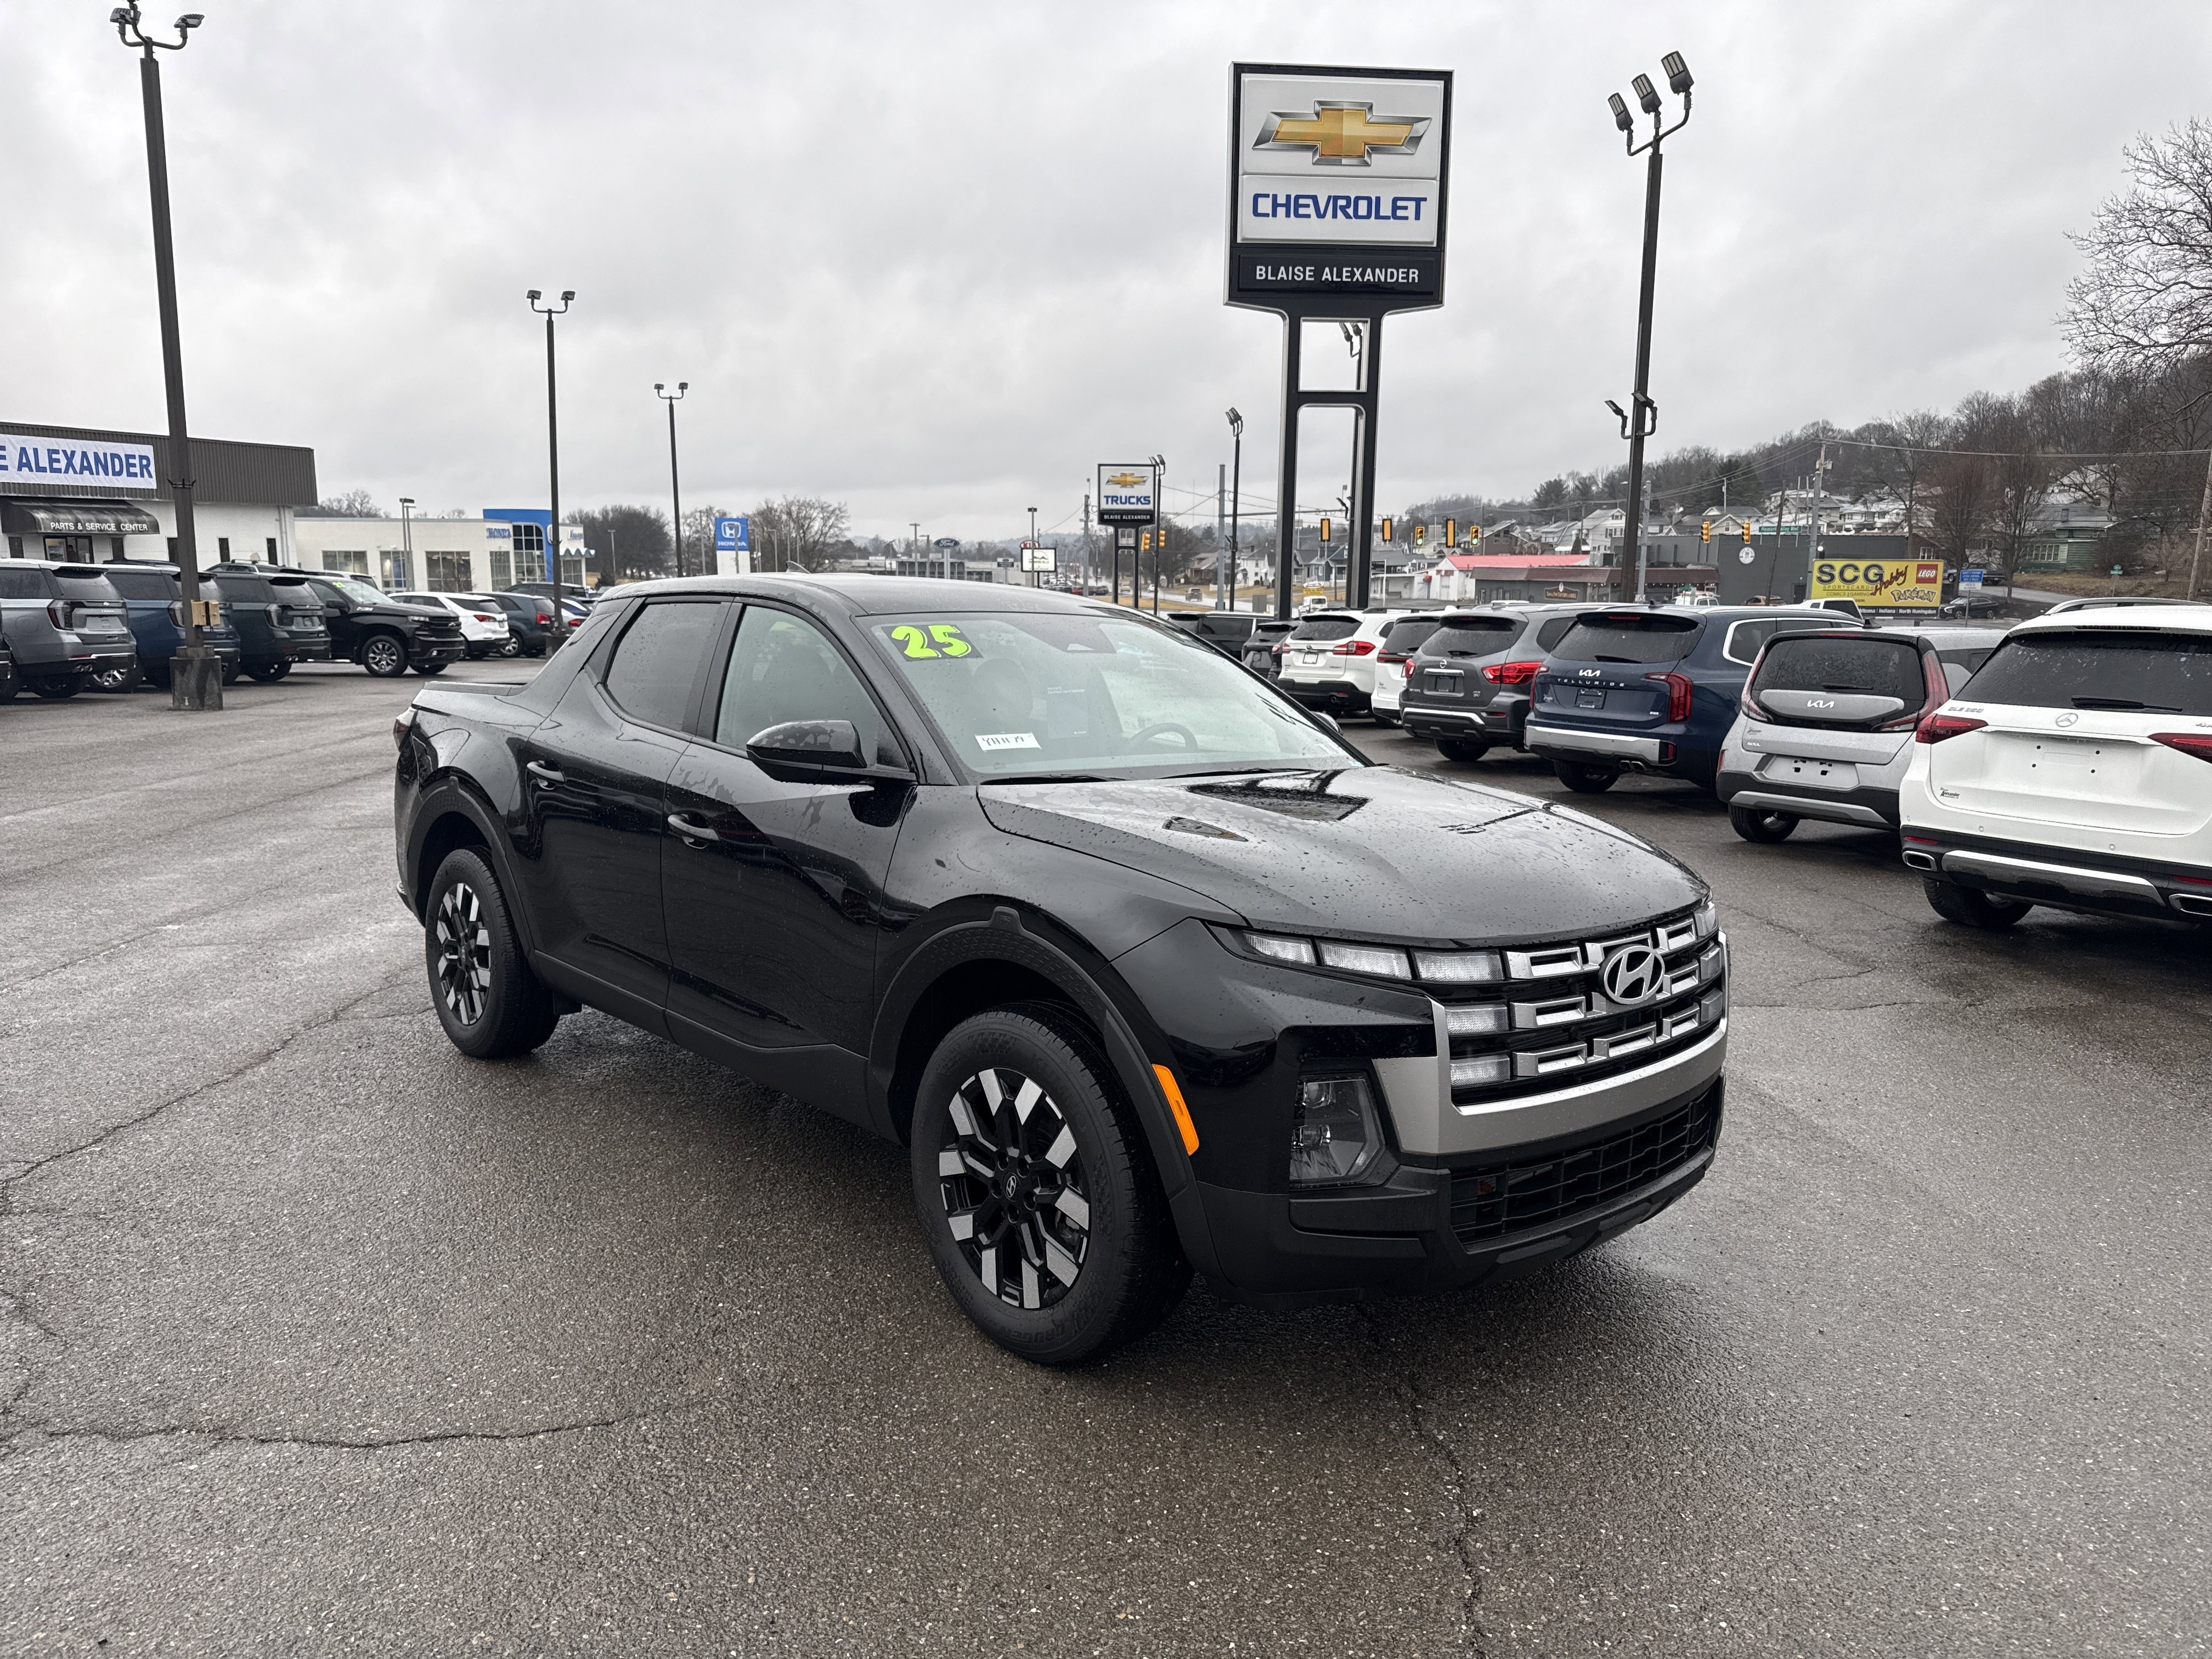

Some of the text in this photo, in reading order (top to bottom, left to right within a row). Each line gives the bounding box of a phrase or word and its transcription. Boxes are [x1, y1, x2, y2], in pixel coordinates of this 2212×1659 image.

[1252, 193, 1427, 221] CHEVROLET
[1256, 266, 1419, 283] BLAISE ALEXANDER
[17, 447, 153, 479] ALEXANDER
[1104, 495, 1151, 505] TRUCKS
[50, 522, 75, 531] PARTS
[86, 523, 116, 531] SERVICE
[939, 539, 955, 548] Ford
[1816, 563, 1884, 585] SCG
[1870, 565, 1908, 596] Hobby
[1918, 568, 1936, 578] LEGO
[891, 625, 972, 658] 25
[1558, 678, 1624, 686] TELLURIDE
